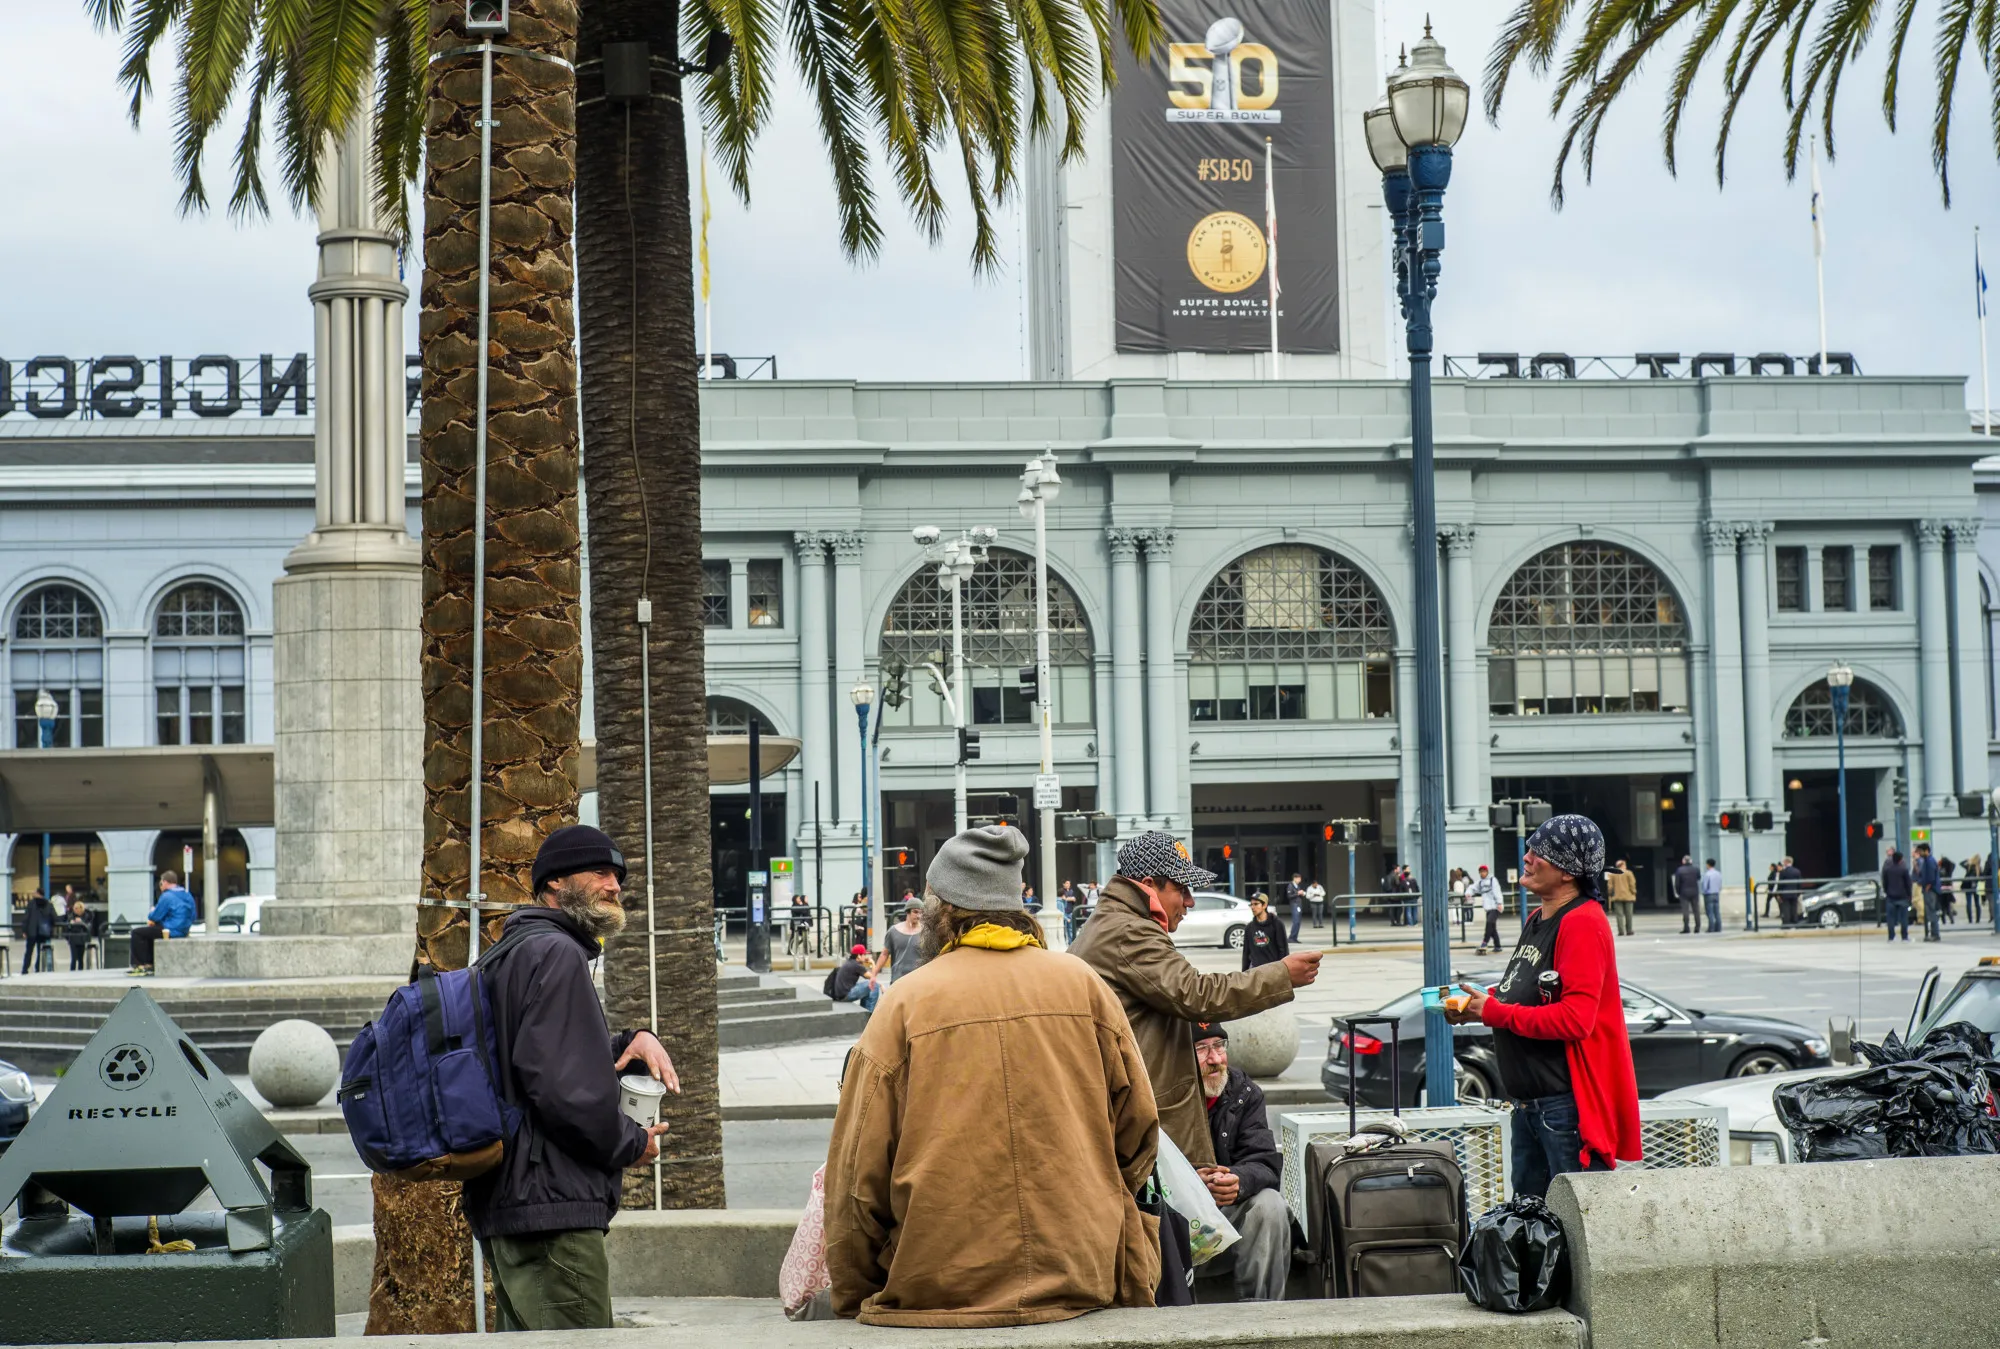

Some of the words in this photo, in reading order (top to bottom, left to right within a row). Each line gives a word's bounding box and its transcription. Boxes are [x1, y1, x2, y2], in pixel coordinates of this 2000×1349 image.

[1168, 42, 1279, 109] 50
[1177, 110, 1224, 120] SUPER
[1231, 111, 1271, 120] BOWL
[1197, 158, 1252, 181] #SB50
[1195, 230, 1207, 247] SAN
[1210, 219, 1259, 248] FRANCISCO
[1204, 271, 1222, 283] BAY
[1229, 270, 1253, 285] AREA
[1179, 299, 1219, 307] SUPER
[1224, 299, 1258, 307] BOWL
[68, 1106, 177, 1120] RECYCLE
